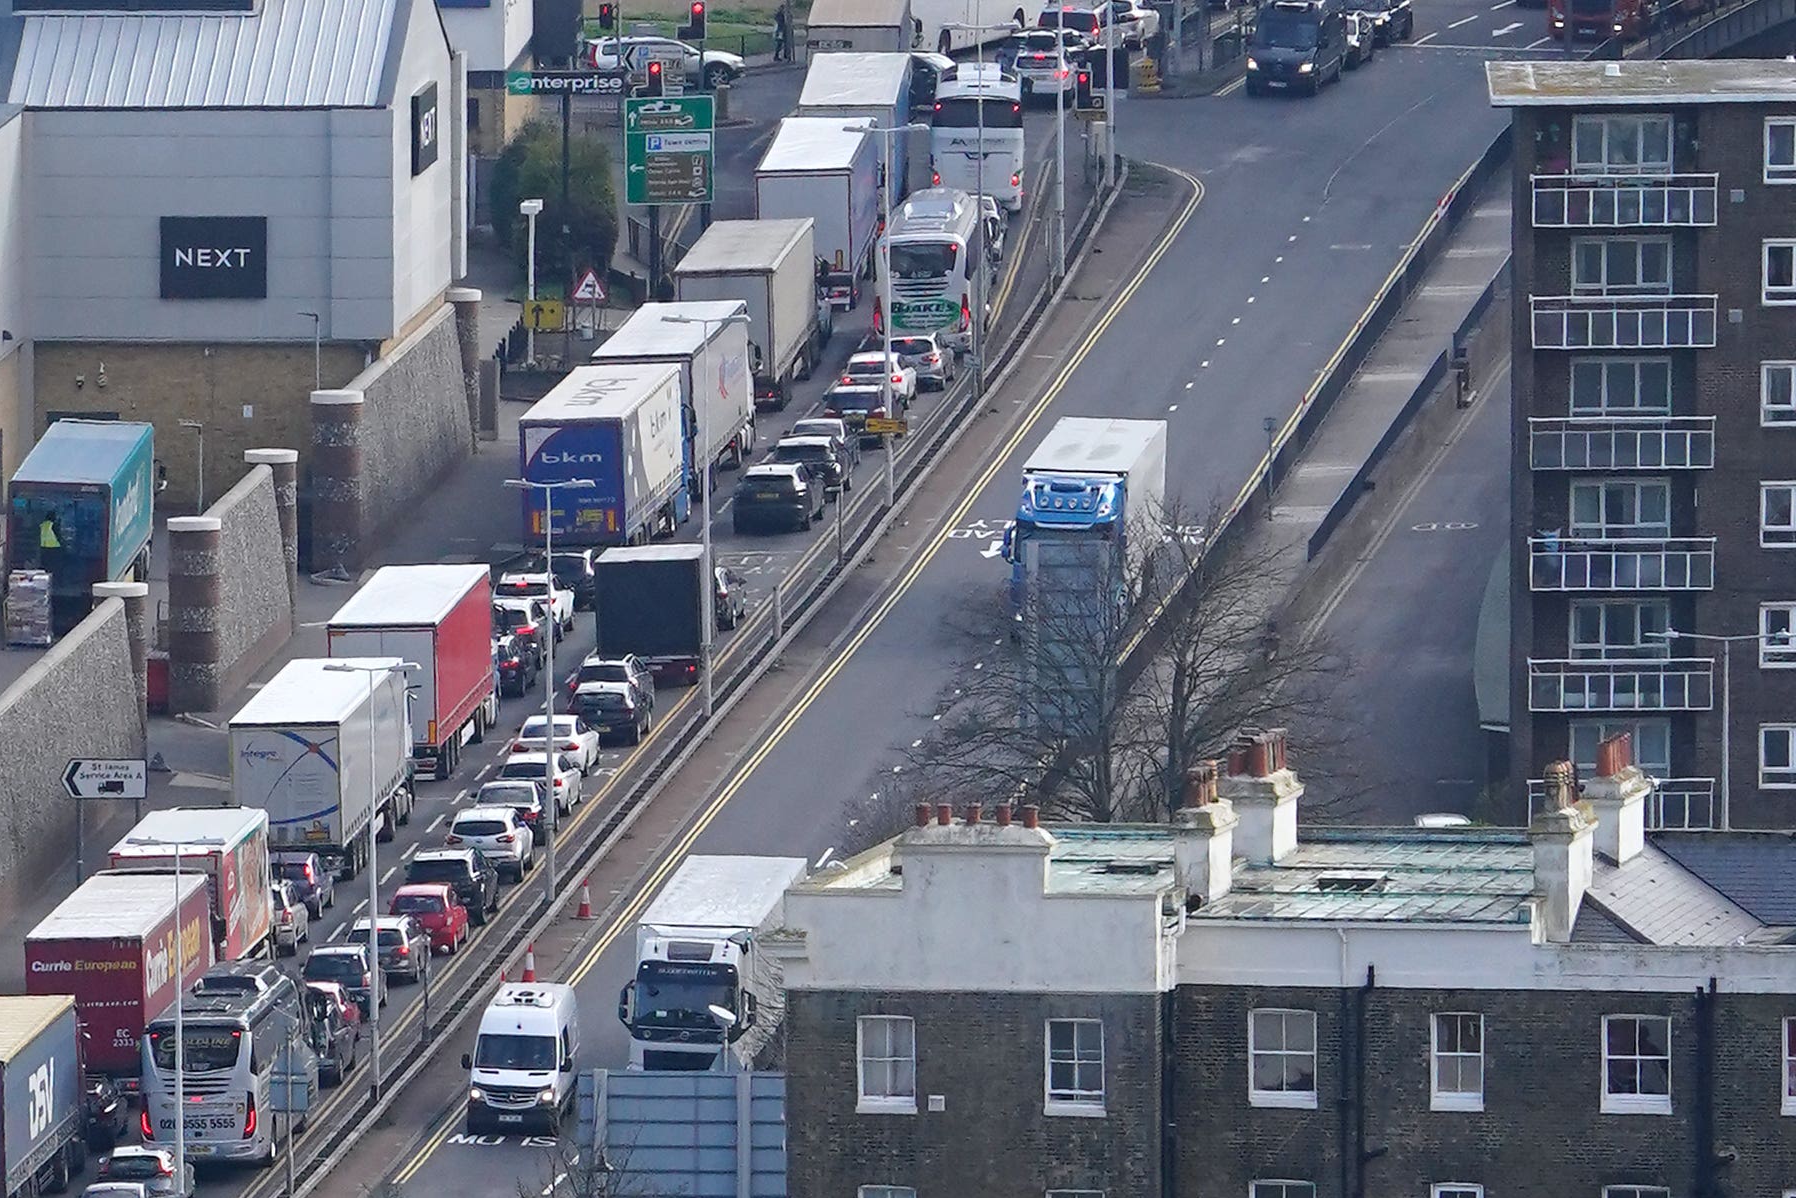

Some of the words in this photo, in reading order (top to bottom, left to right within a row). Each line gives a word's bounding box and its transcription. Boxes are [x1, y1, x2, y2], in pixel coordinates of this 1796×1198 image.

[515, 75, 622, 92] enterprise
[174, 248, 251, 268] NEXT
[541, 452, 602, 463] bkm
[91, 763, 101, 771] St
[31, 961, 72, 972] Currie
[74, 960, 136, 973] European
[29, 1057, 54, 1140] DSV
